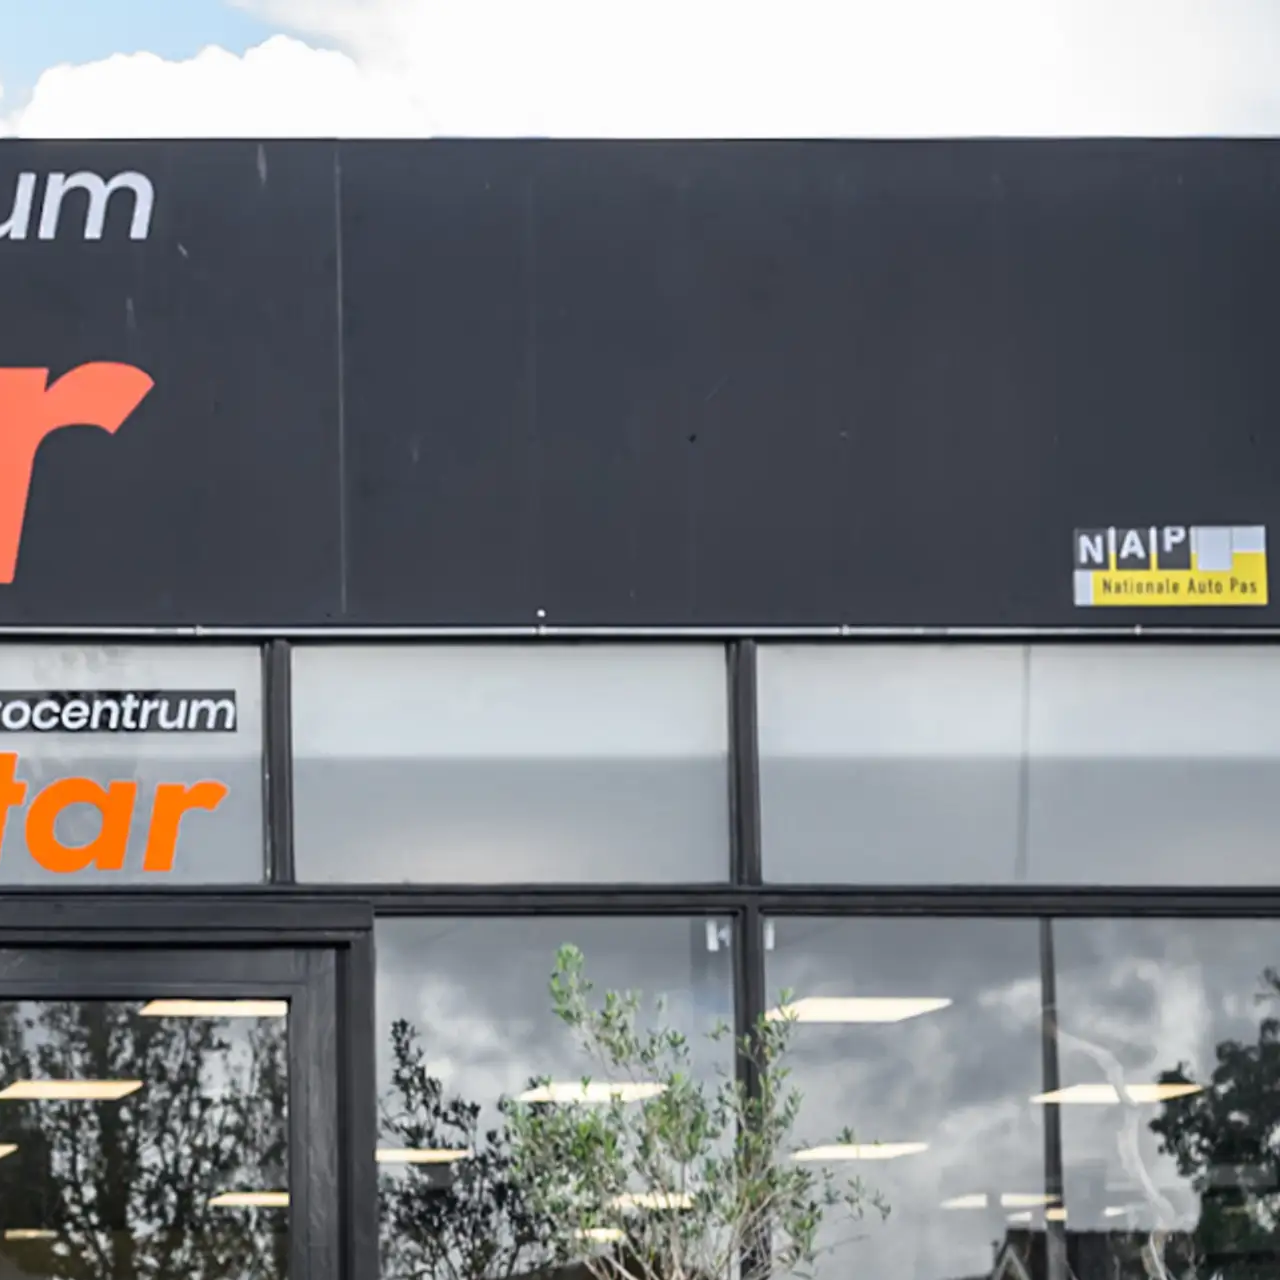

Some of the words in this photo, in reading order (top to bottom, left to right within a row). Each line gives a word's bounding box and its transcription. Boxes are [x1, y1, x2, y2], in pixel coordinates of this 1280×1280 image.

[1101, 577, 1180, 595] Nationale
[1186, 577, 1224, 595] Auto
[1229, 576, 1258, 594] Pas
